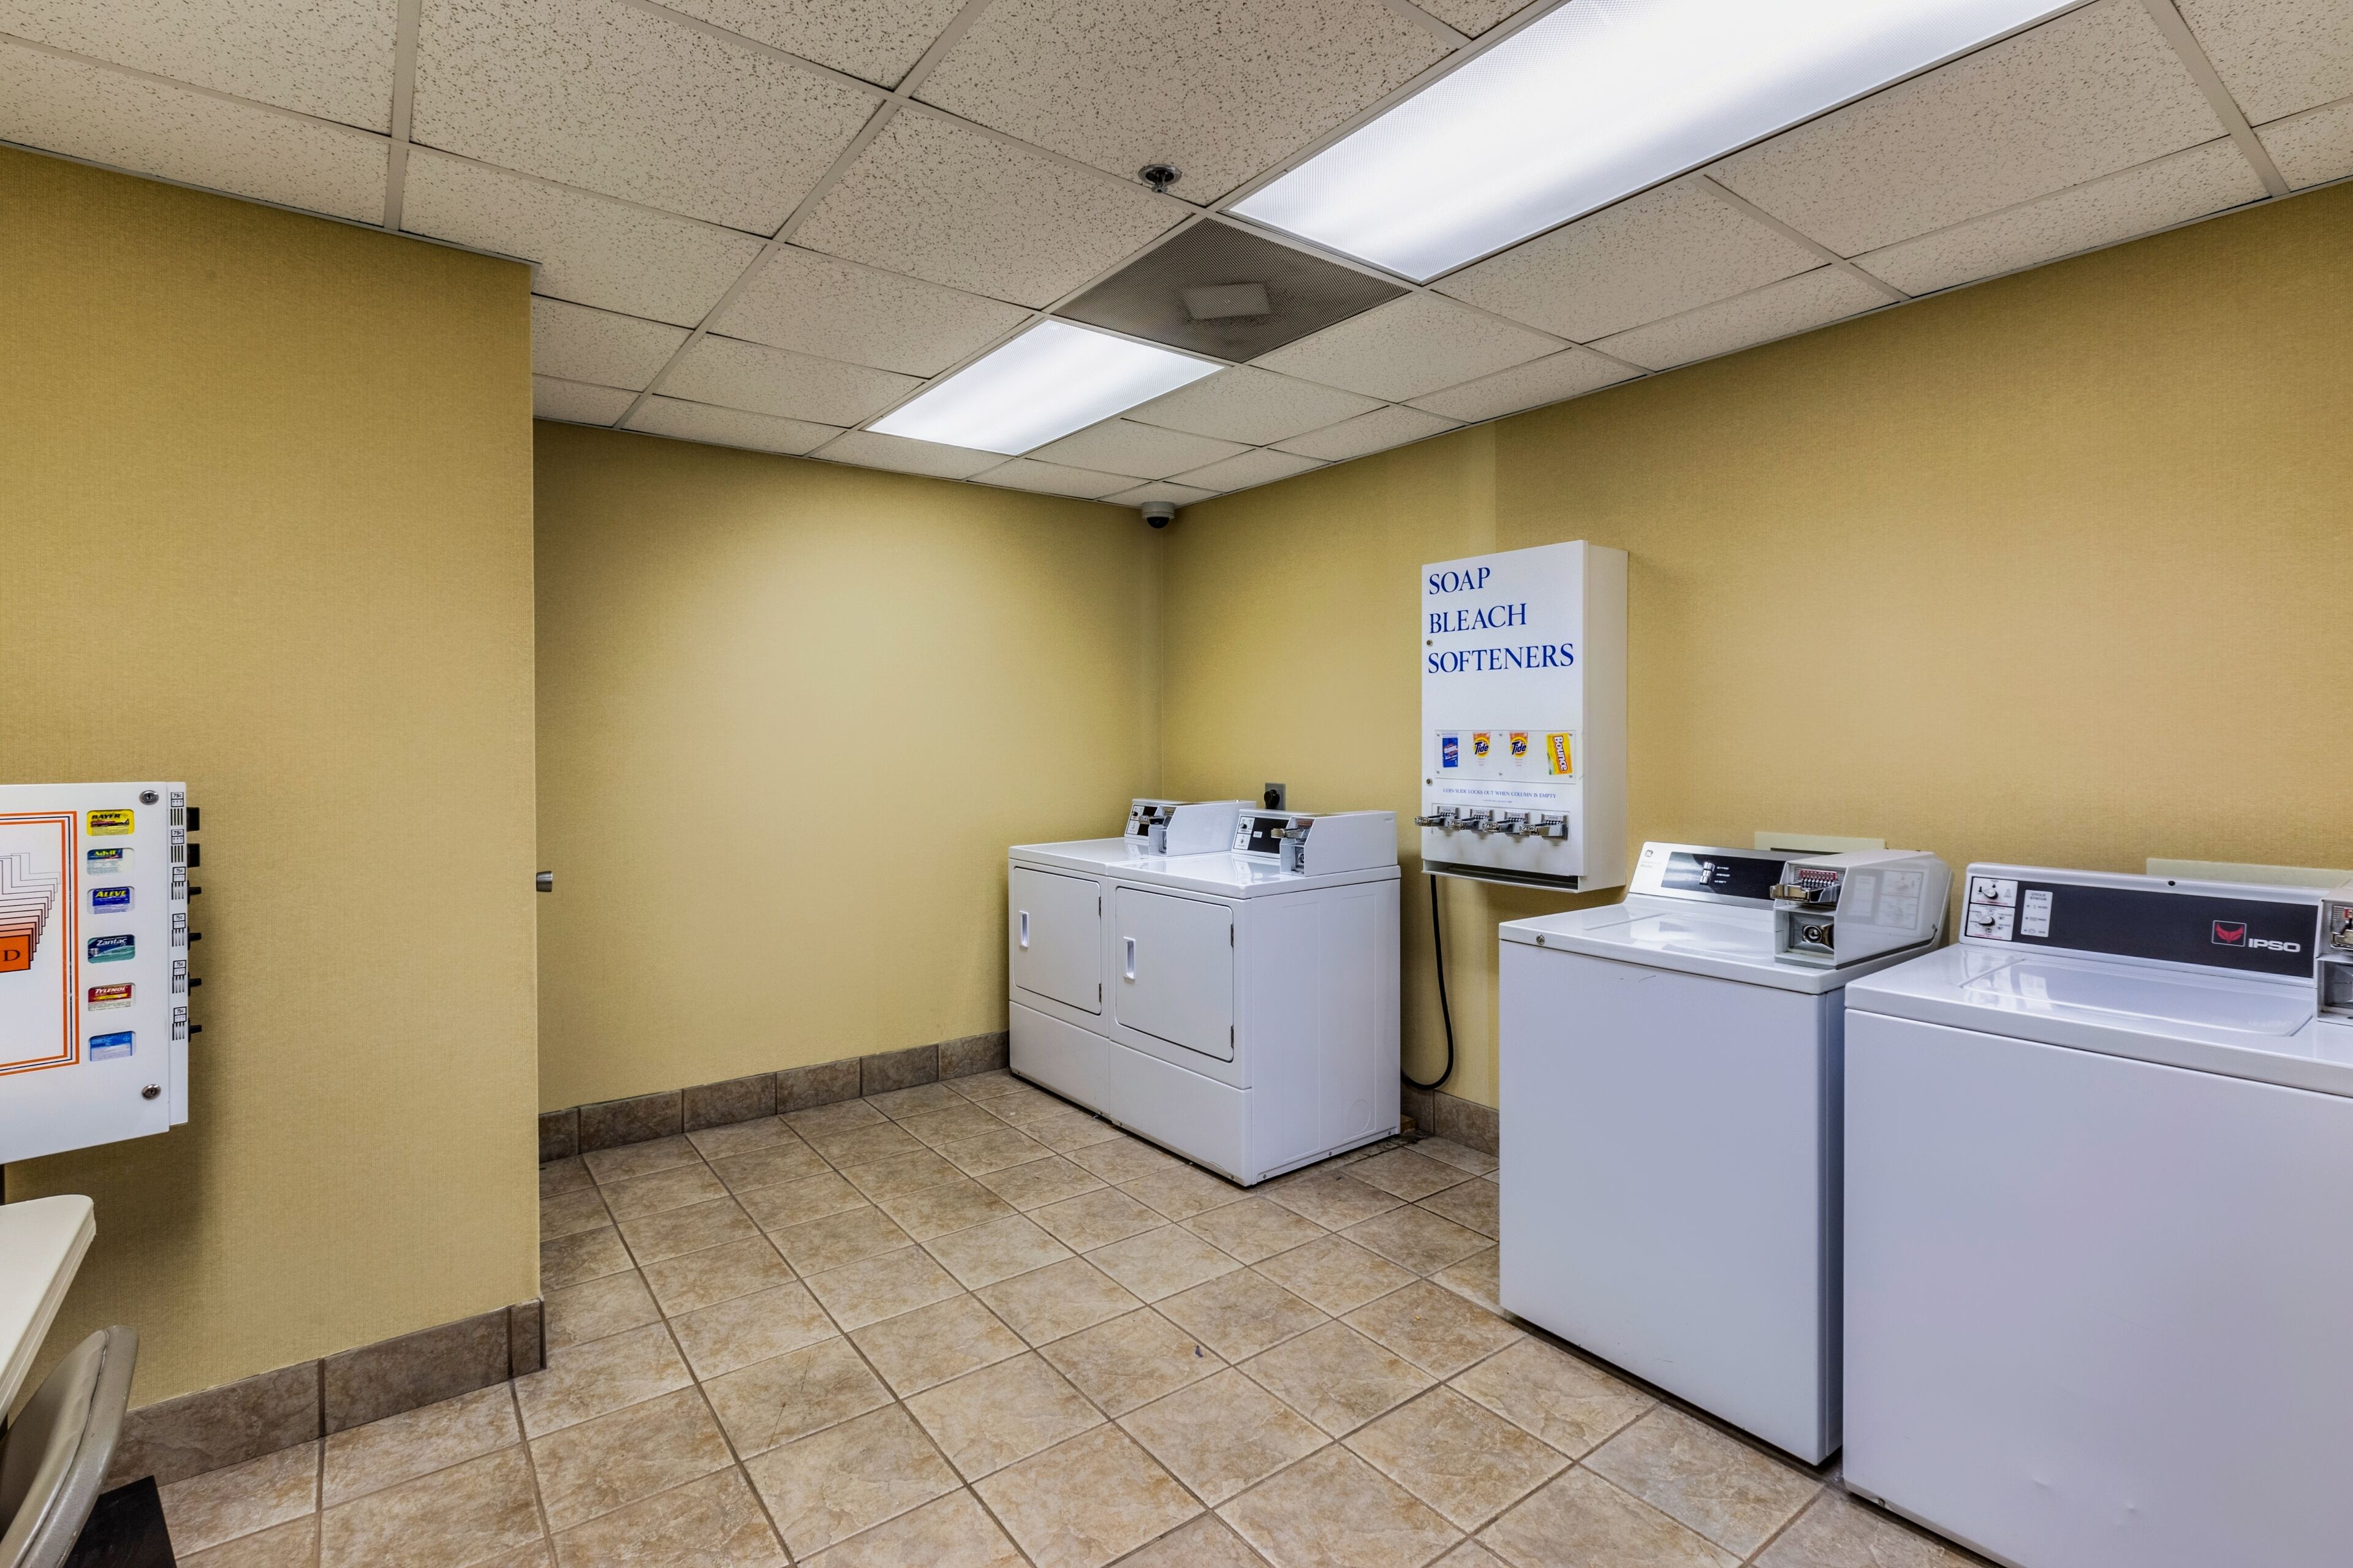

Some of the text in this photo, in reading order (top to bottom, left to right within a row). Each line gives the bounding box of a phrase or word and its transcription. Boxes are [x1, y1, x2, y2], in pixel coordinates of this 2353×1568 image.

[1429, 567, 1491, 595] SOAP
[1429, 603, 1527, 634] BLEACH
[1428, 643, 1574, 673] SOFTENERS
[1474, 741, 1489, 755] Tide
[1512, 741, 1526, 755] Tide
[2248, 938, 2301, 953] IPSO
[2, 949, 21, 961] D
